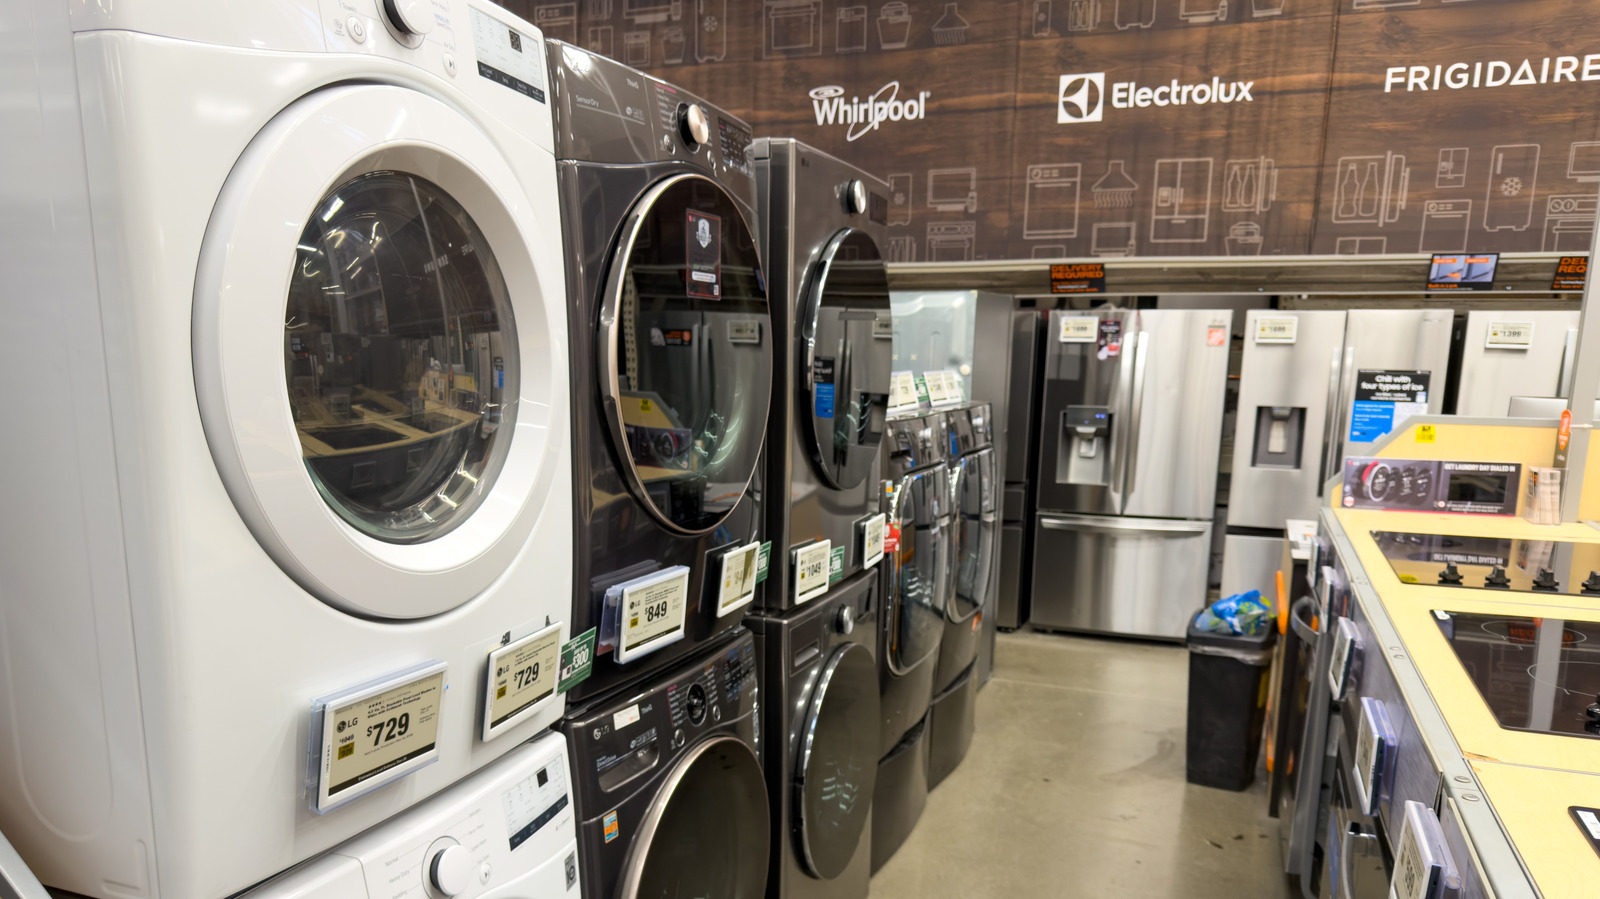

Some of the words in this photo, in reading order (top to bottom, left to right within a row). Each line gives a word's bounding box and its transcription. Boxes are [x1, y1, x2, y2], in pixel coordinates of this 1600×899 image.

[1384, 53, 1600, 93] FRIGIDAIRE
[1112, 76, 1254, 108] Electrolux
[812, 90, 926, 131] Whirlpool
[1051, 264, 1102, 272] DELIVERY
[1051, 271, 1104, 279] REQUIRED
[1361, 381, 1378, 390] four
[1378, 382, 1401, 392] types
[1401, 382, 1410, 390] of
[1375, 374, 1392, 383] Chill
[1393, 375, 1411, 383] with
[1444, 462, 1454, 470] GET
[1455, 463, 1478, 471] LAUNDRY
[644, 601, 667, 622] $849
[572, 648, 589, 668] $300
[514, 662, 539, 690] $729
[366, 712, 410, 747] $729
